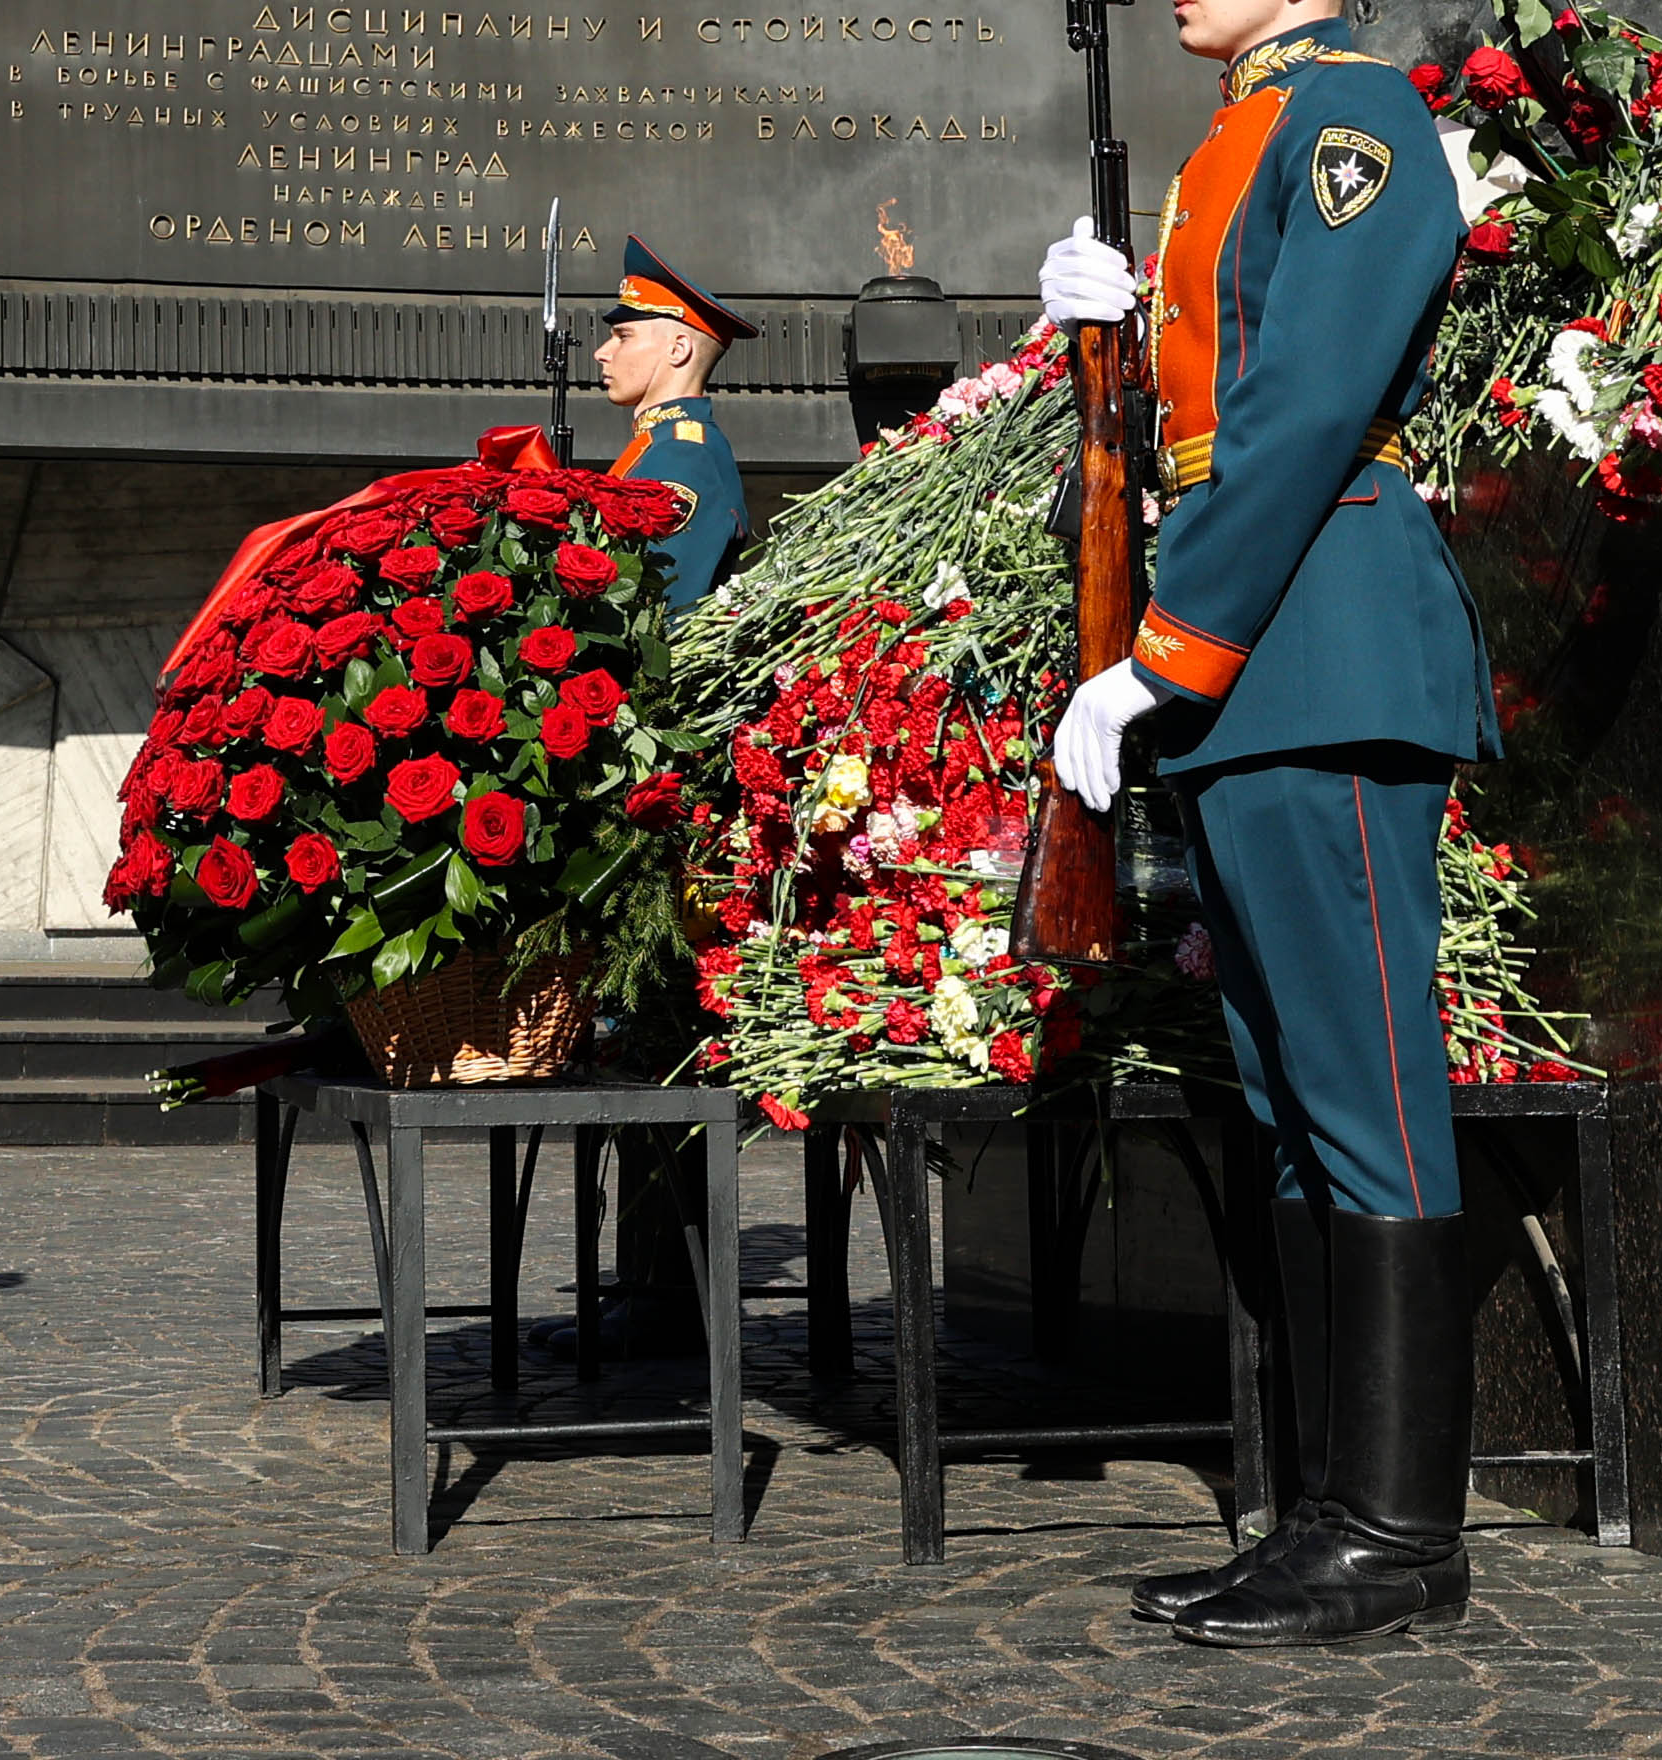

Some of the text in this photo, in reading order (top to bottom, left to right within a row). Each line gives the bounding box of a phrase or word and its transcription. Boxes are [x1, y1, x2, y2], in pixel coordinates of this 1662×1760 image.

[253, 4, 1005, 46] ДИСЦИПЛИНУ И СТОЙКОСТЬ,
[29, 29, 436, 71] ЛЕНИНГРАДЦАМИ
[9, 65, 826, 105] В БОРЬБЕ С ФАШИСТСКИМИ ЗАХВАТЧИКАМИ
[10, 100, 1019, 145] В ТРУДНЫХ УСЛОВИЯХ ВРАЖЕСКОЙ БЛОКАДЫ,
[1325, 132, 1349, 144] МЧС
[236, 142, 510, 179] ЛЕНИНГРАД
[273, 184, 475, 210] НАГРАЖДЕН
[149, 213, 599, 253] ОРДЕНОМ ЛЕНИНА
